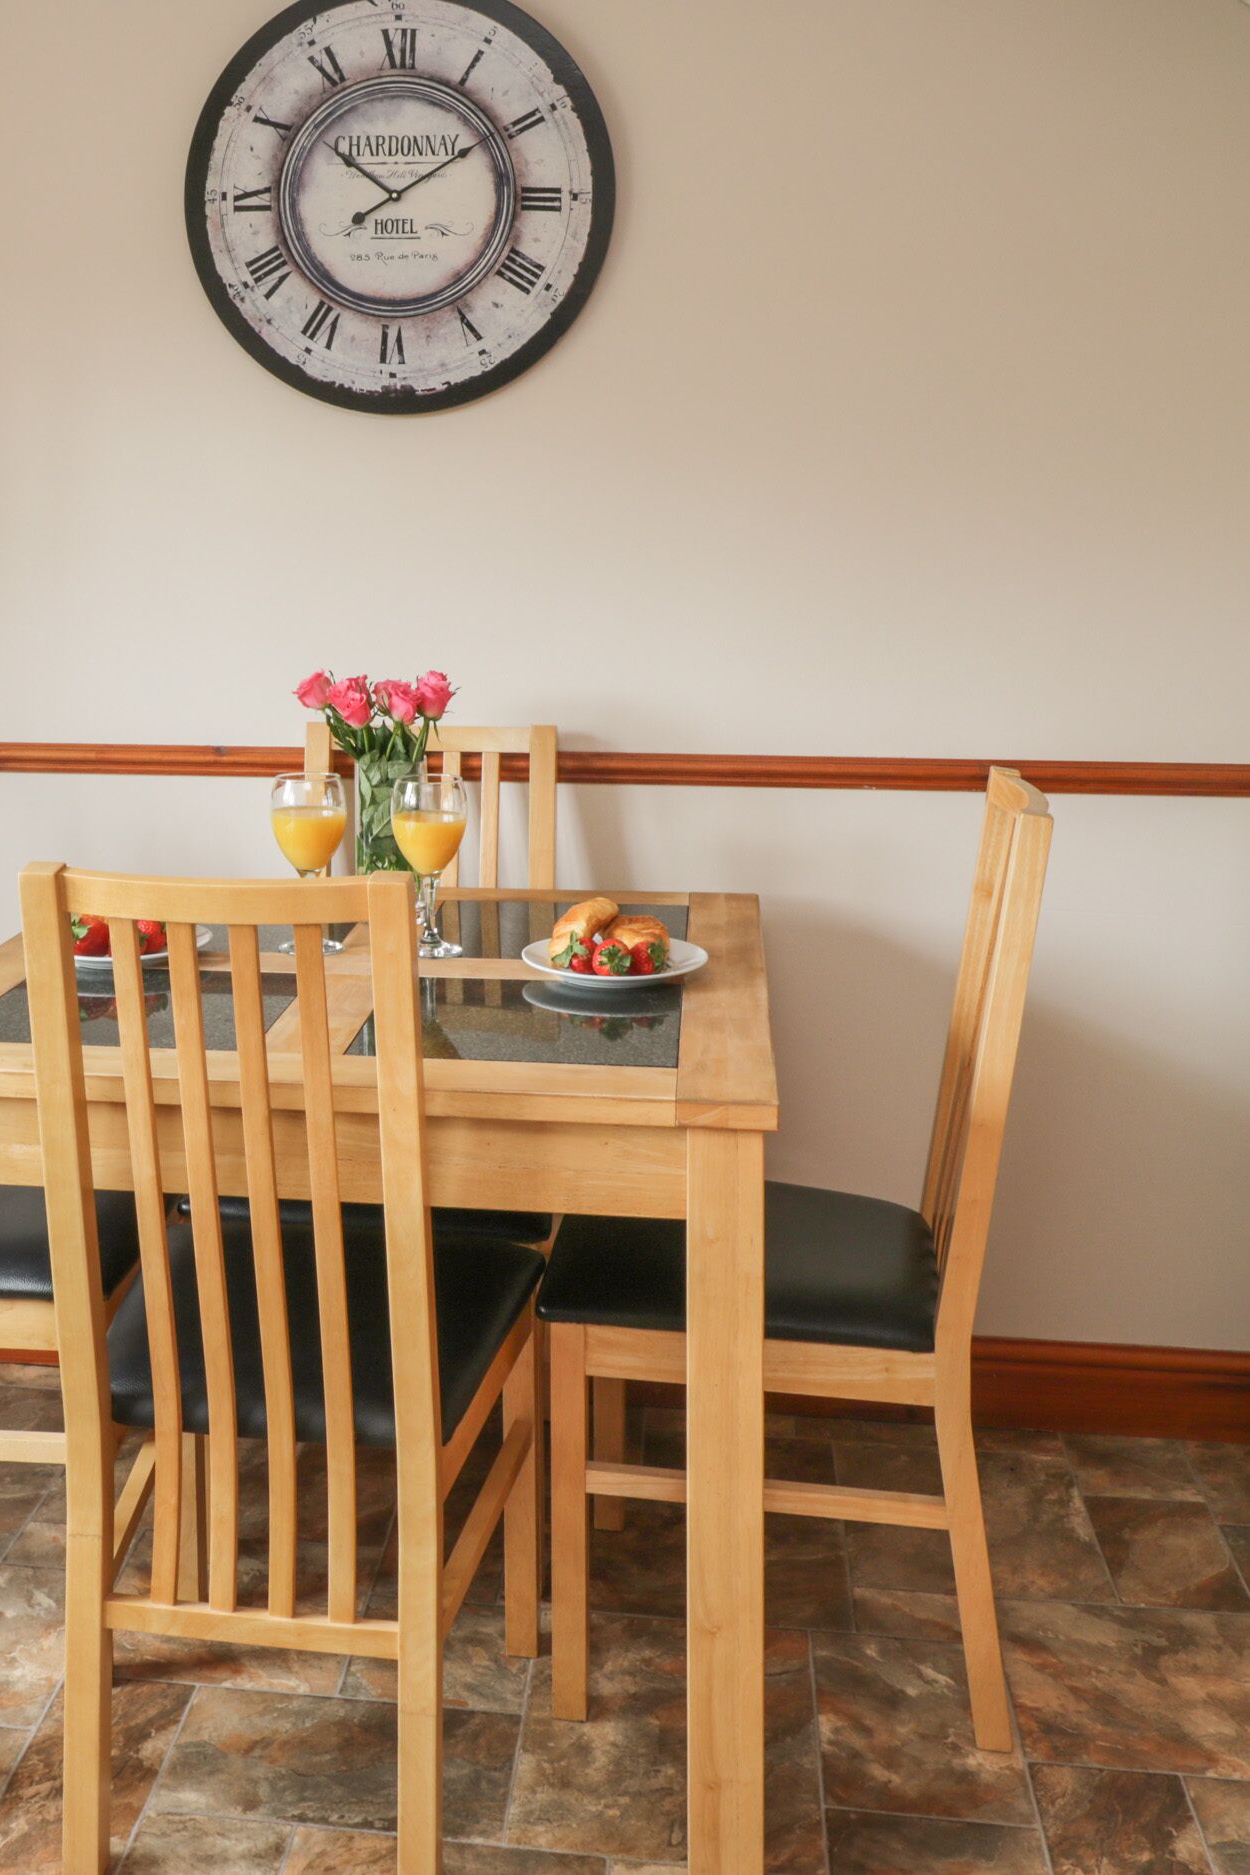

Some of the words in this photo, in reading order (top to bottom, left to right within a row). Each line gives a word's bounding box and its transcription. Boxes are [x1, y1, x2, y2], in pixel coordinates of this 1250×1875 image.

[377, 28, 419, 71] XII
[252, 104, 293, 142] X
[502, 107, 546, 140] II
[334, 133, 460, 158] CHARDONNAY
[520, 184, 562, 214] III
[374, 218, 418, 235] HOTEL
[375, 251, 395, 265] Rue
[398, 251, 411, 260] de
[410, 250, 439, 261] Paris
